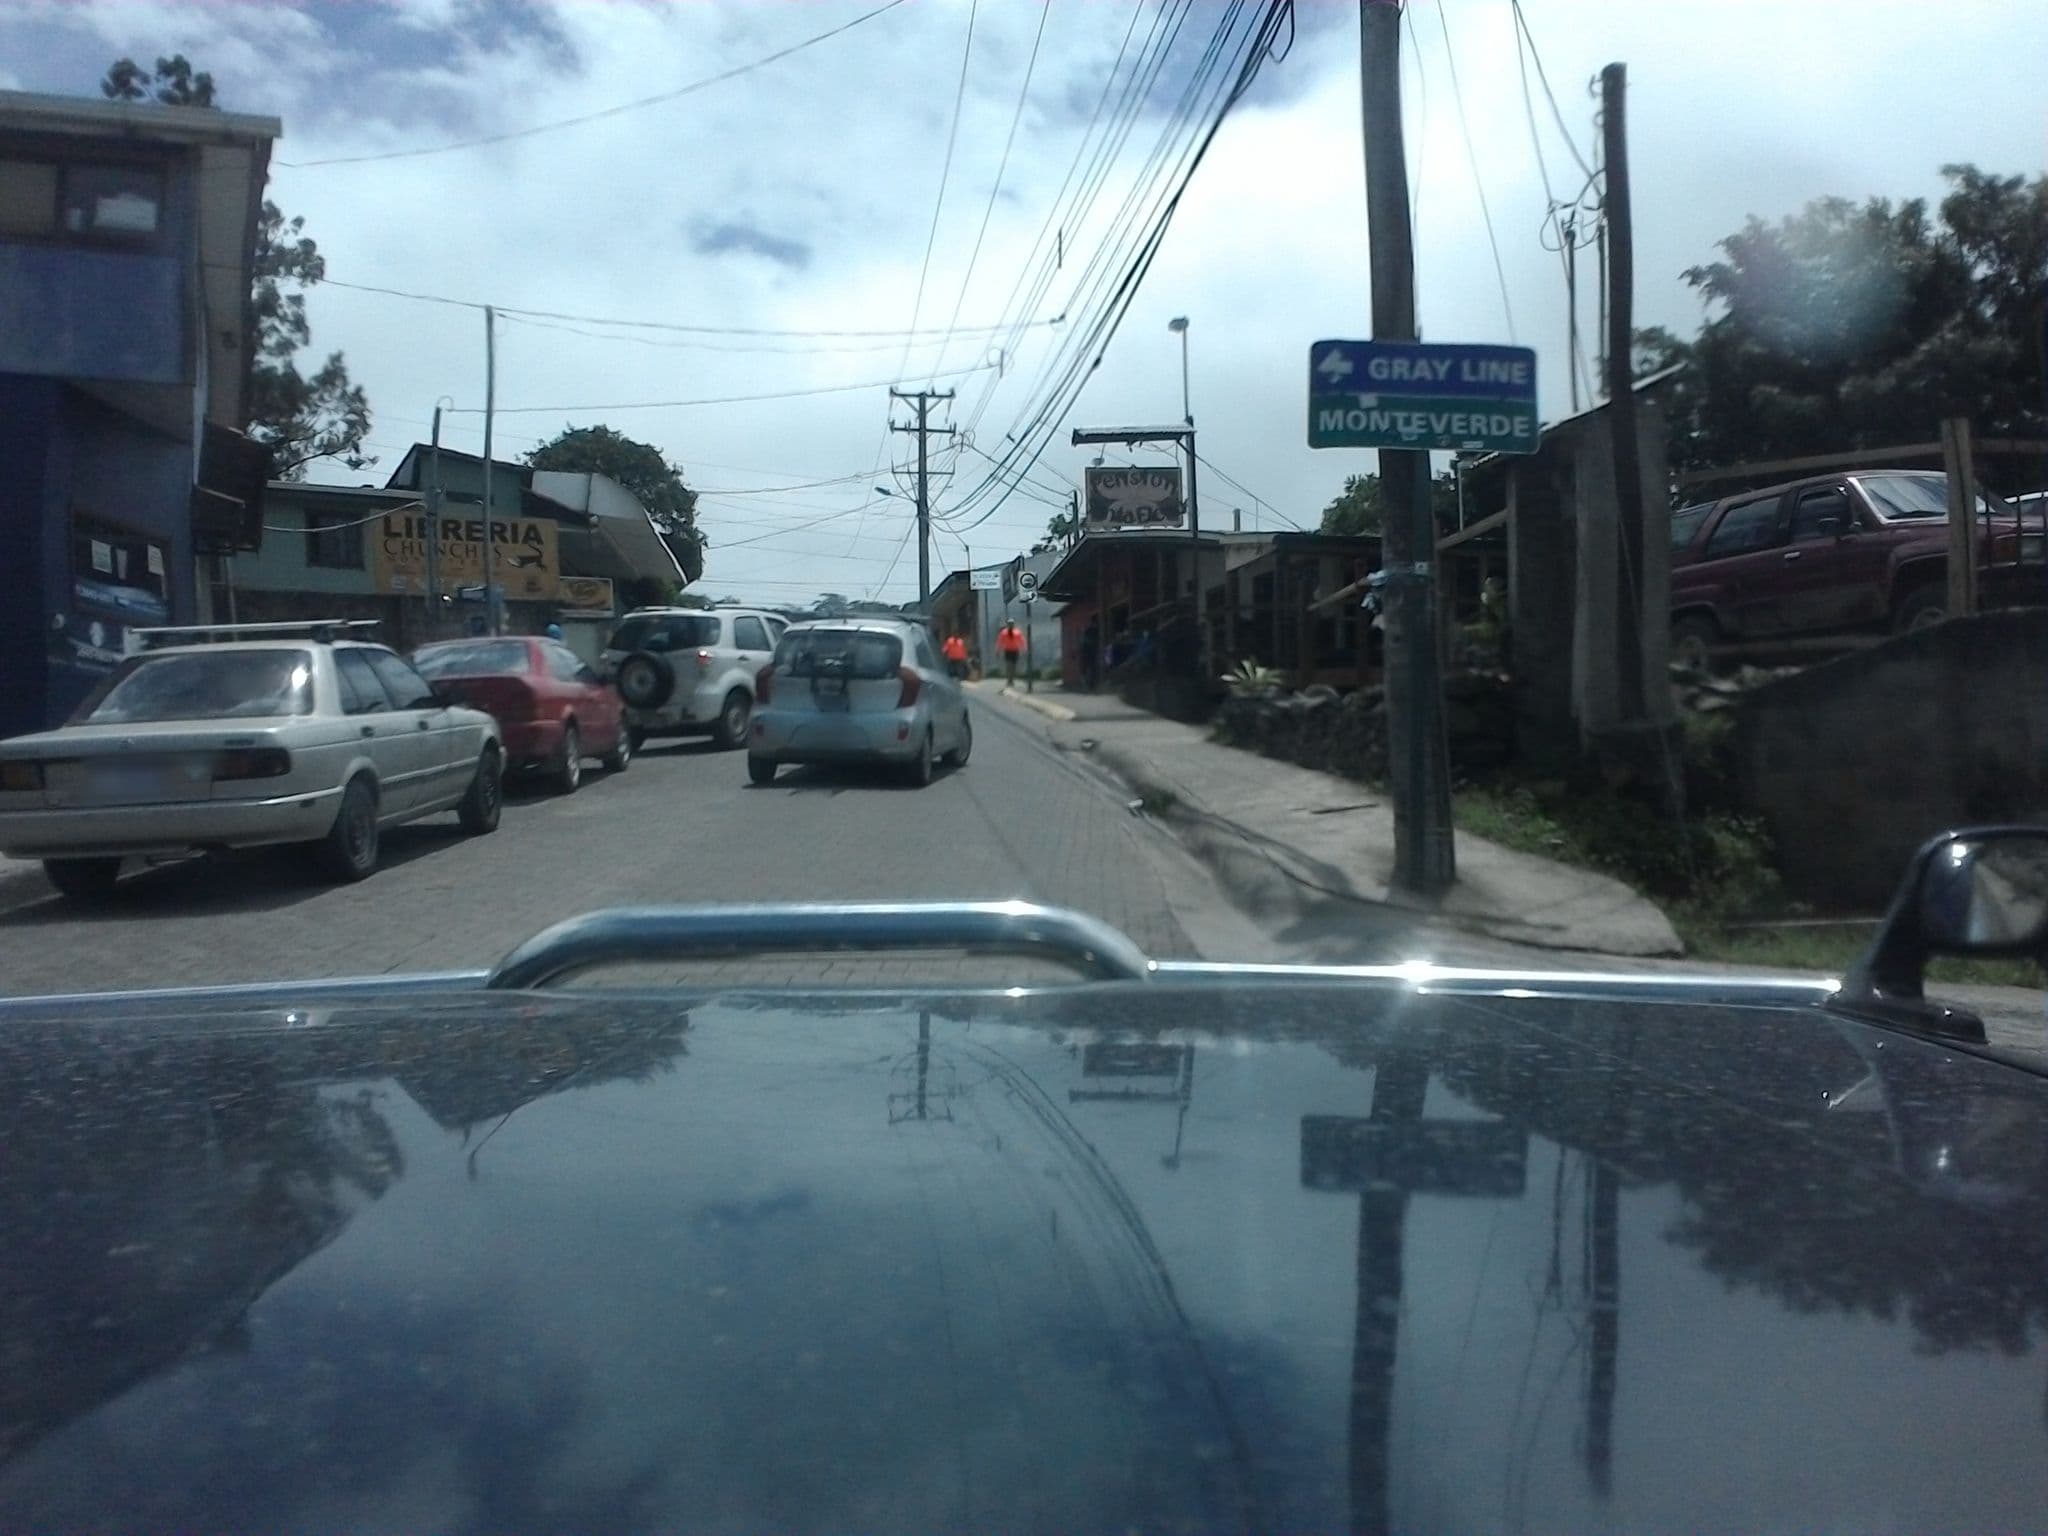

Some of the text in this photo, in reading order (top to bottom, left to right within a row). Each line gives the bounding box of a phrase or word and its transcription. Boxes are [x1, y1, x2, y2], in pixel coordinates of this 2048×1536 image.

[1368, 356, 1528, 385] GRAY LINE
[1318, 408, 1531, 438] MONTEVERDE
[383, 538, 503, 559] CHUNCHS
